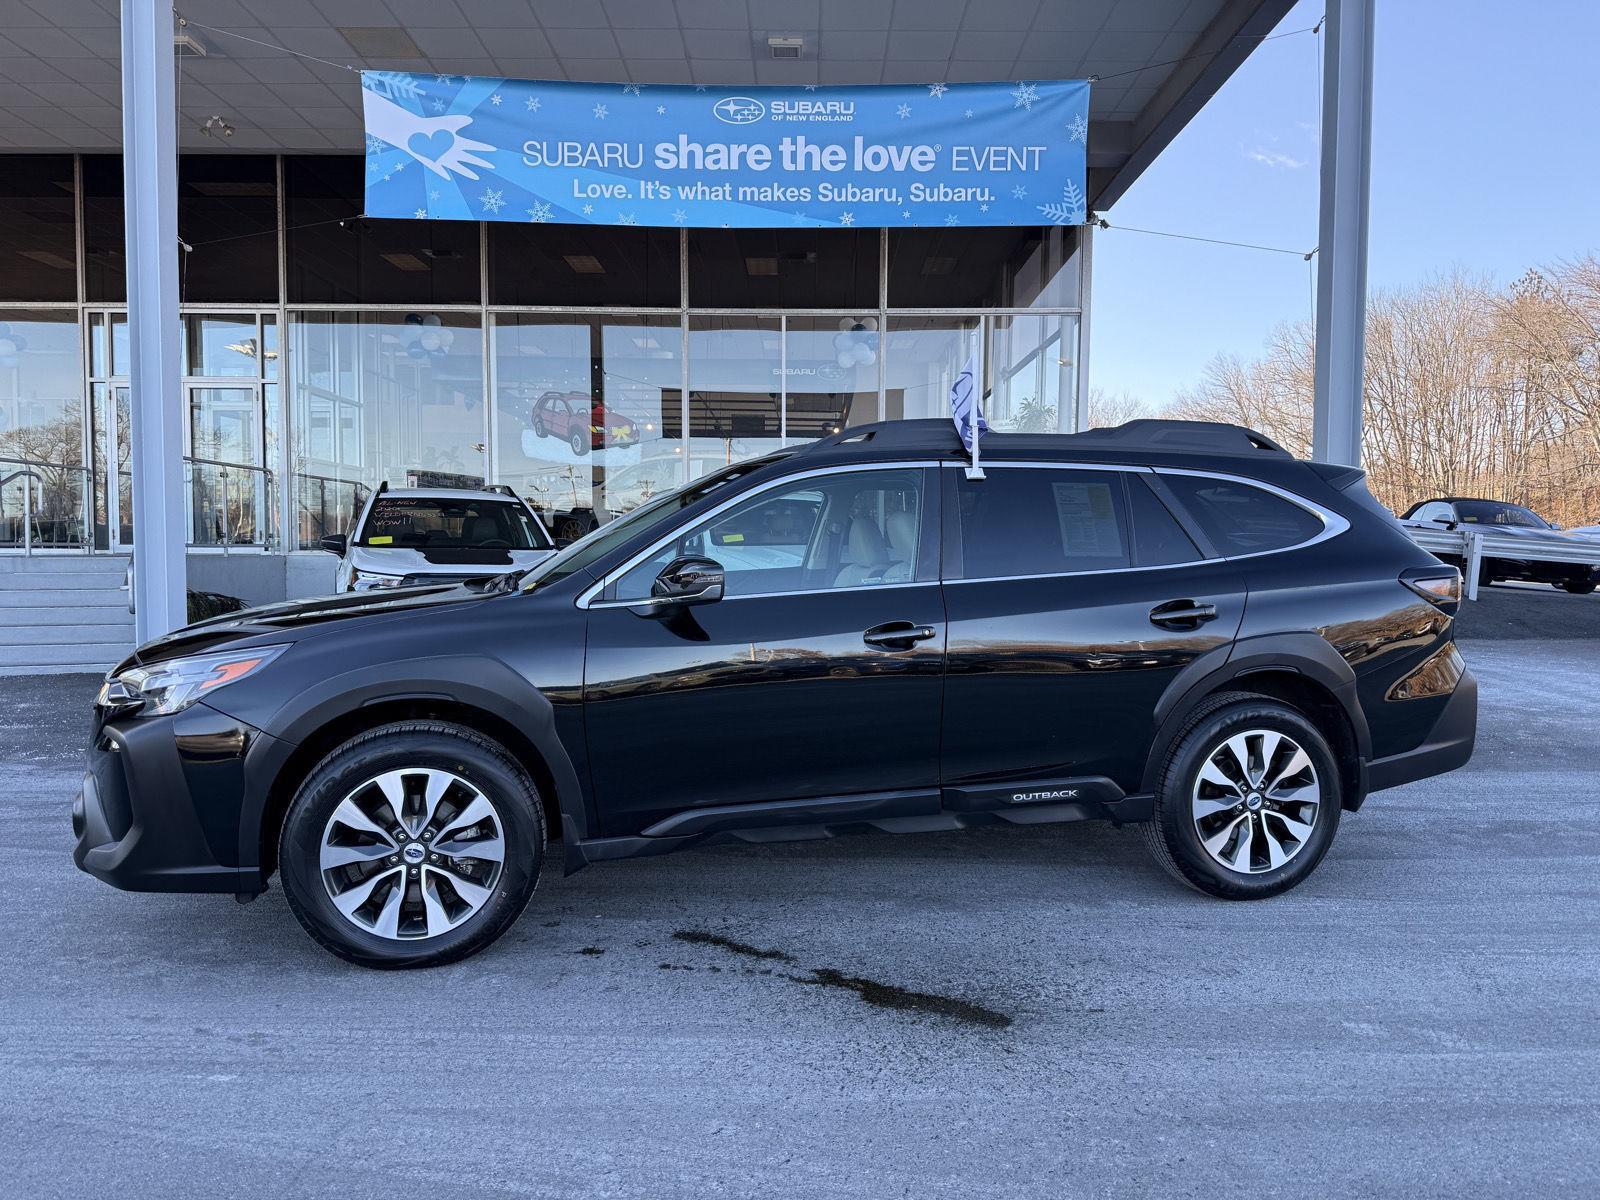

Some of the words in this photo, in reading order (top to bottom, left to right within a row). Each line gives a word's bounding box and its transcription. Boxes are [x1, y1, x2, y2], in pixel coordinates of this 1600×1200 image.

[522, 140, 643, 169] SUBARU
[654, 133, 772, 171] share
[778, 135, 847, 172] the
[952, 146, 1047, 171] EVENT
[573, 178, 633, 199] Love.
[677, 181, 732, 201] what
[738, 182, 812, 202] makes
[817, 182, 903, 206] Subaru,
[909, 182, 996, 202] Subaru.
[1012, 789, 1079, 802] OUTBACK
